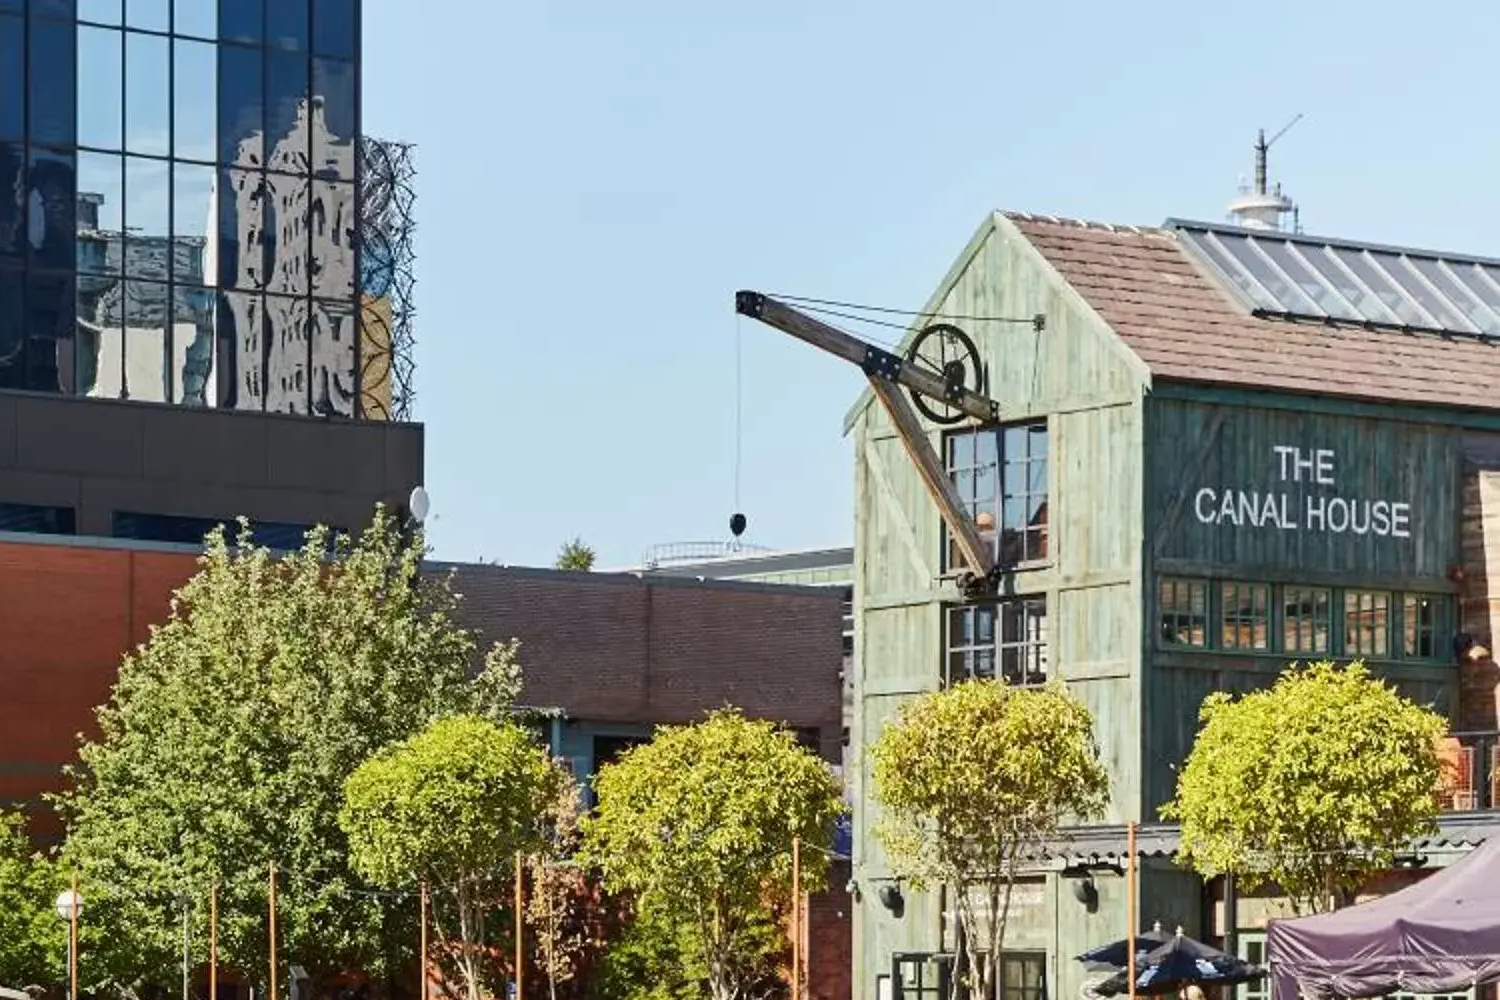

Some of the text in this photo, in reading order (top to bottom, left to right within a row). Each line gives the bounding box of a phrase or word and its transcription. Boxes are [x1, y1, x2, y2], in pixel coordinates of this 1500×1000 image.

[1273, 446, 1335, 485] THE
[1194, 488, 1411, 538] CANAL HOUSE
